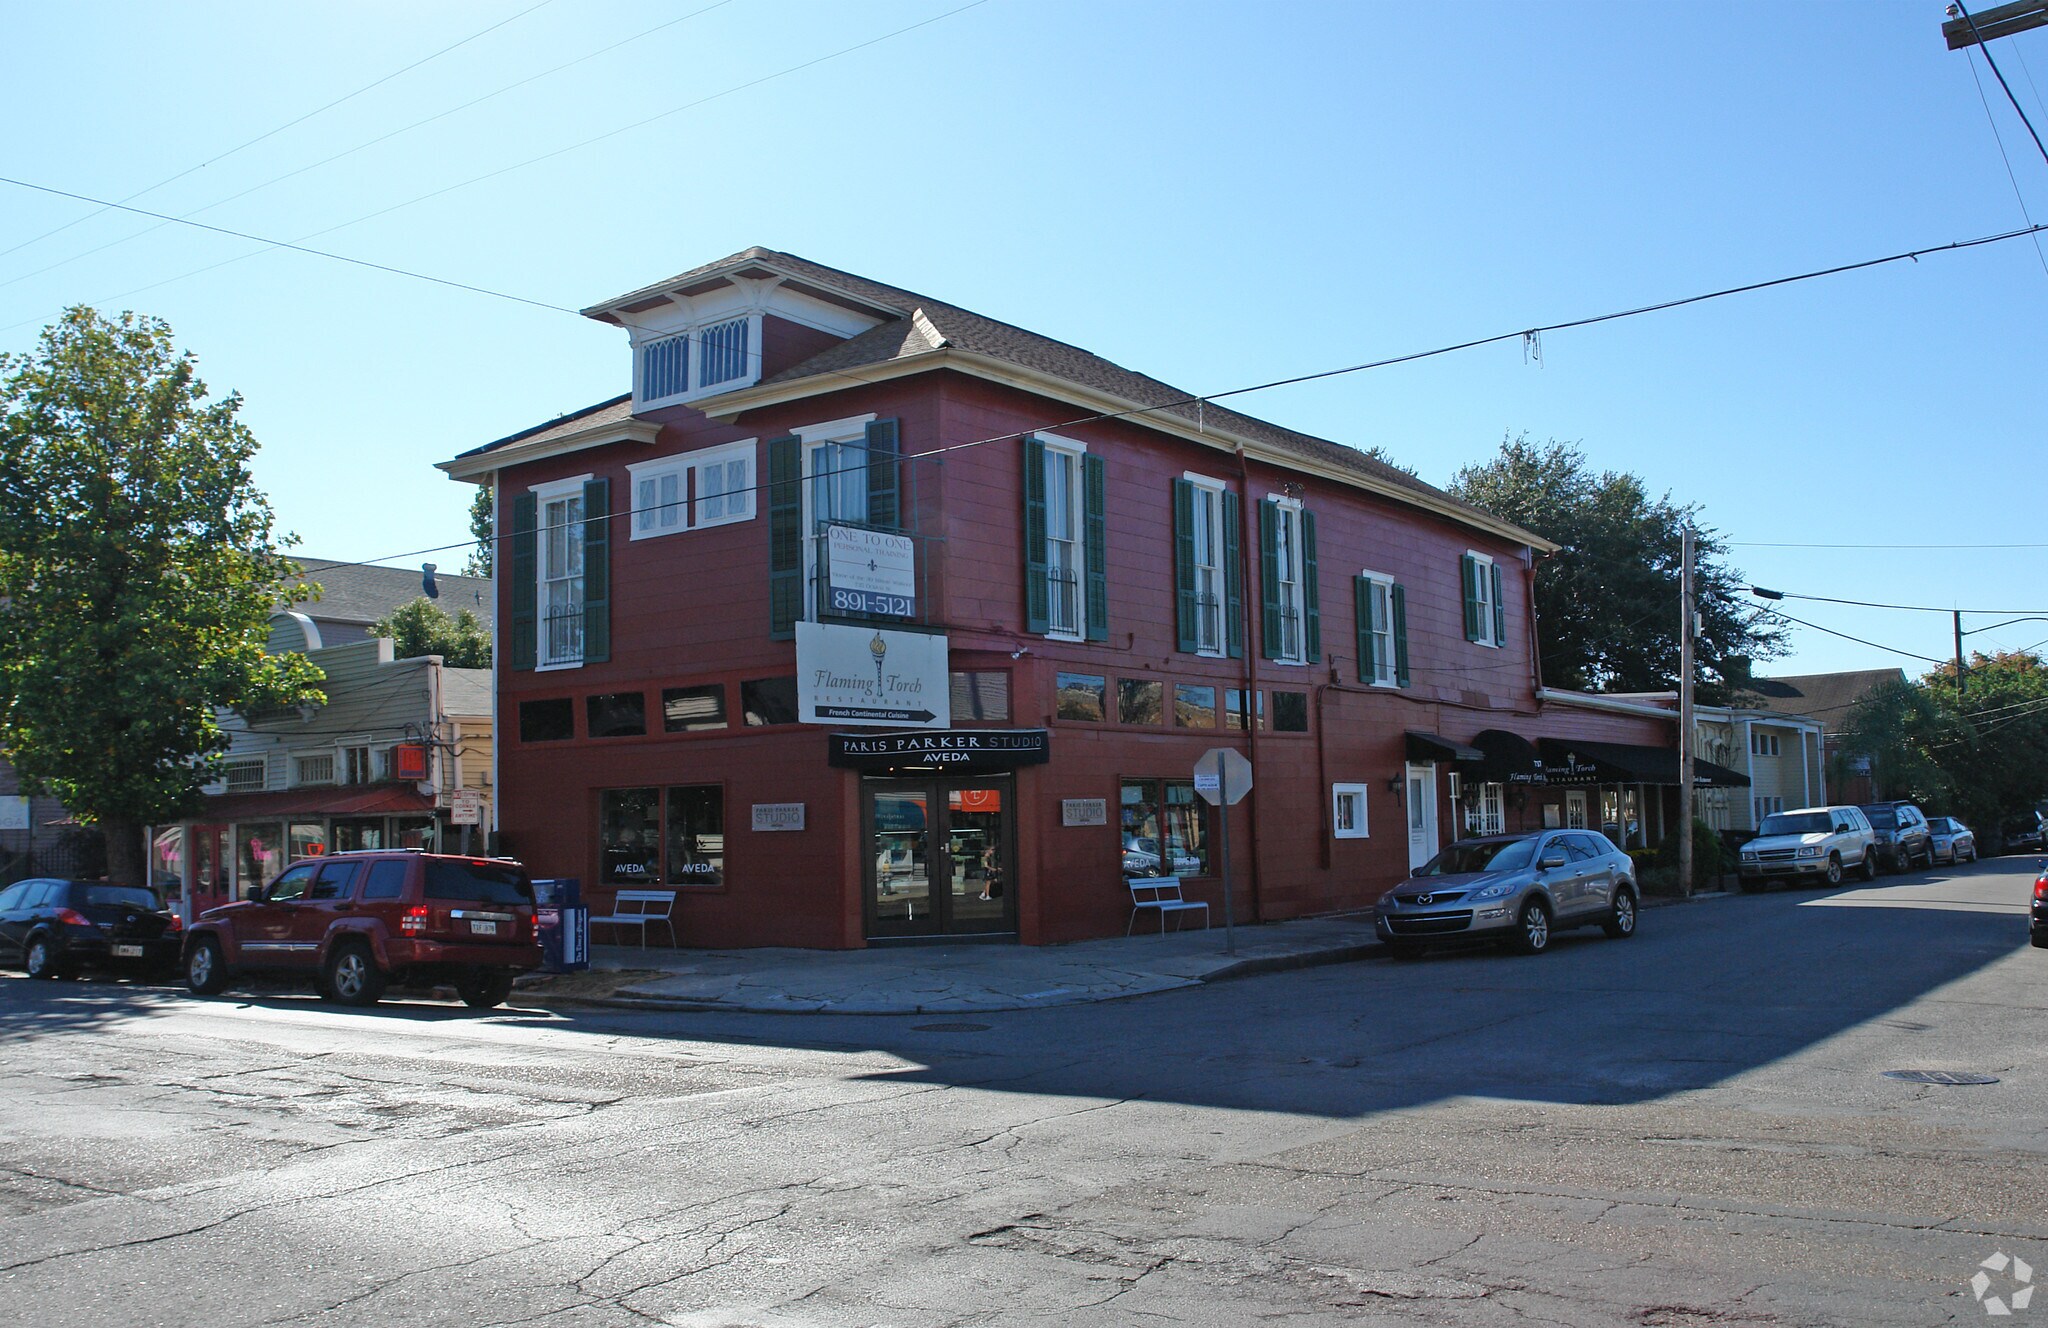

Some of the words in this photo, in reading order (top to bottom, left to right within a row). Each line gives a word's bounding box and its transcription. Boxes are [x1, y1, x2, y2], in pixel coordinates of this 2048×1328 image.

[830, 528, 857, 542] ONE
[863, 533, 880, 545] TO
[885, 538, 911, 550] ONE
[833, 542, 872, 554] PERSONAL
[876, 548, 909, 559] TRAINING
[834, 590, 912, 616] 891-5121
[814, 669, 874, 696] Flaming
[886, 674, 922, 693] Torch
[814, 696, 923, 707] RESTAURANT
[828, 709, 850, 717] French
[851, 710, 888, 719] Continental
[888, 711, 910, 720] Cuisine
[844, 741, 887, 752] PARIS
[897, 737, 981, 750] PARKER
[989, 737, 1042, 748] STUDIO
[923, 753, 970, 762] AVEDA
[1576, 764, 1596, 772] Torch
[755, 812, 800, 822] STUDIO
[1065, 808, 1103, 818] STUDIO
[615, 864, 645, 873] AVEDA
[682, 864, 715, 873] AVEDA
[1123, 859, 1151, 869] AVEDA
